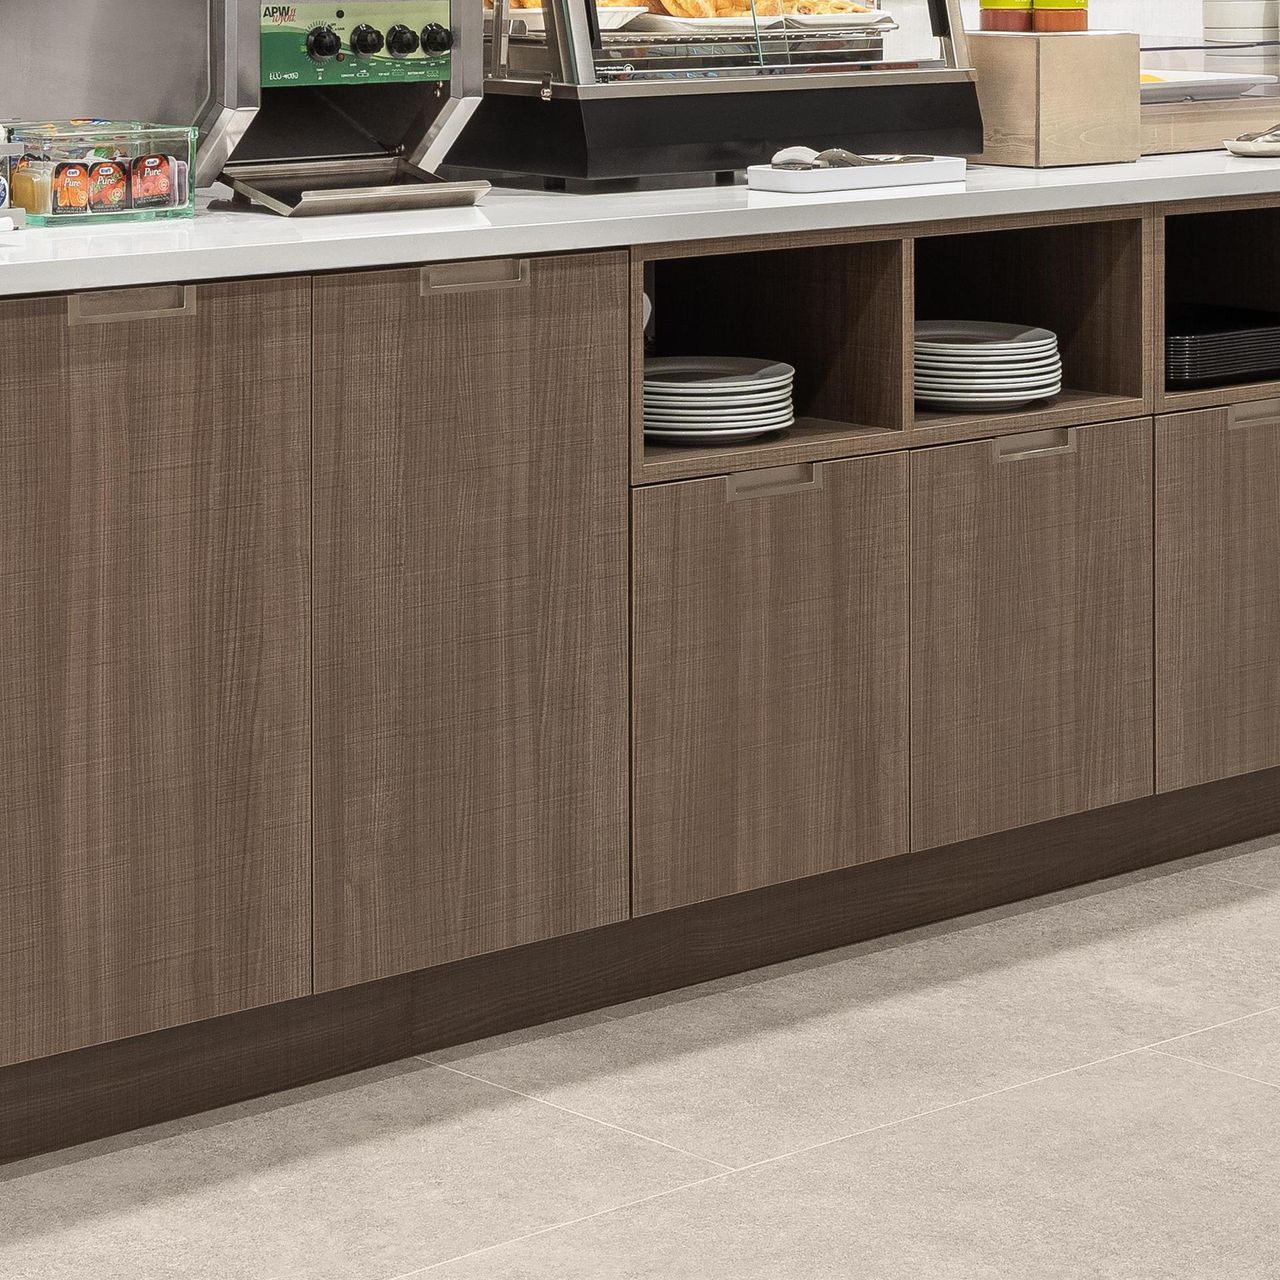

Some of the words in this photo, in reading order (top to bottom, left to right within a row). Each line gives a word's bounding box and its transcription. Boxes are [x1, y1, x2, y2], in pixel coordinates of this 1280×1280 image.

[263, 6, 290, 18] APW
[144, 167, 162, 177] Pure
[64, 177, 81, 188] Pure
